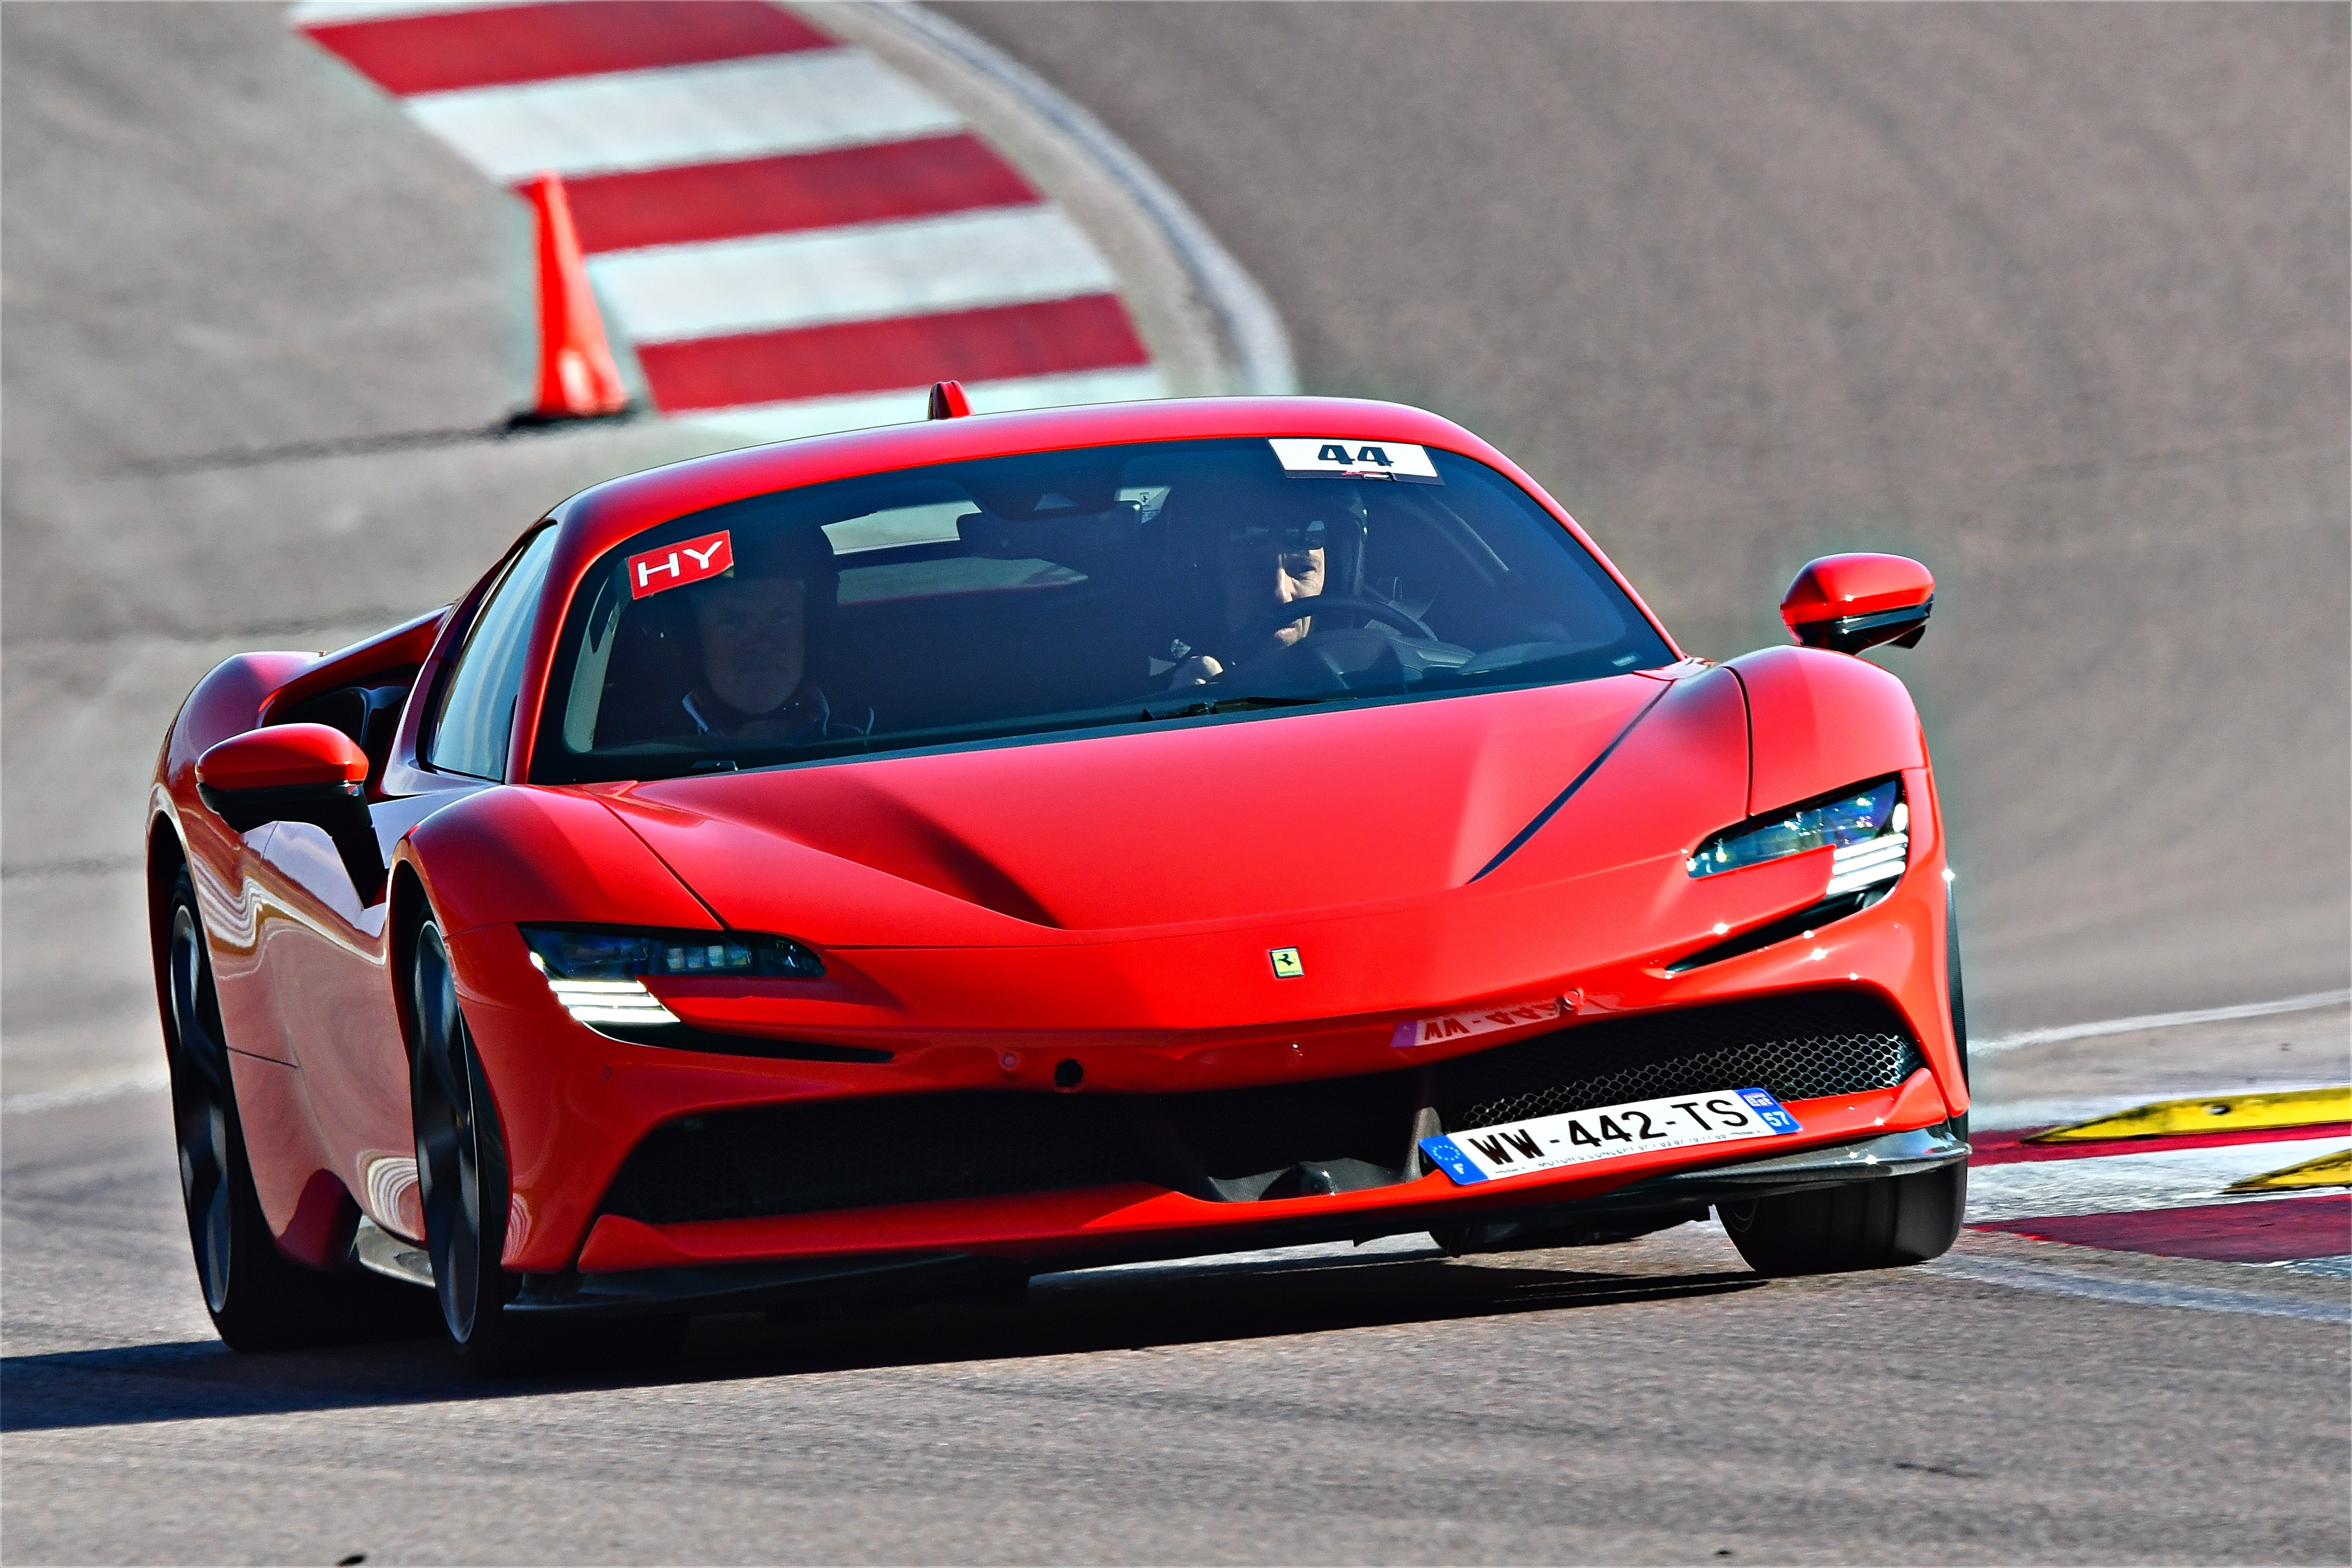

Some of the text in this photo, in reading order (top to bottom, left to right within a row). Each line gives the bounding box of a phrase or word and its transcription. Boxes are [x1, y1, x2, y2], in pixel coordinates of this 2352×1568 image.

[1318, 444, 1395, 467] 44
[637, 540, 723, 587] HY
[1761, 1111, 1790, 1127] 57
[1467, 1099, 1748, 1165] WW-442-TS
[1453, 1163, 1465, 1175] F
